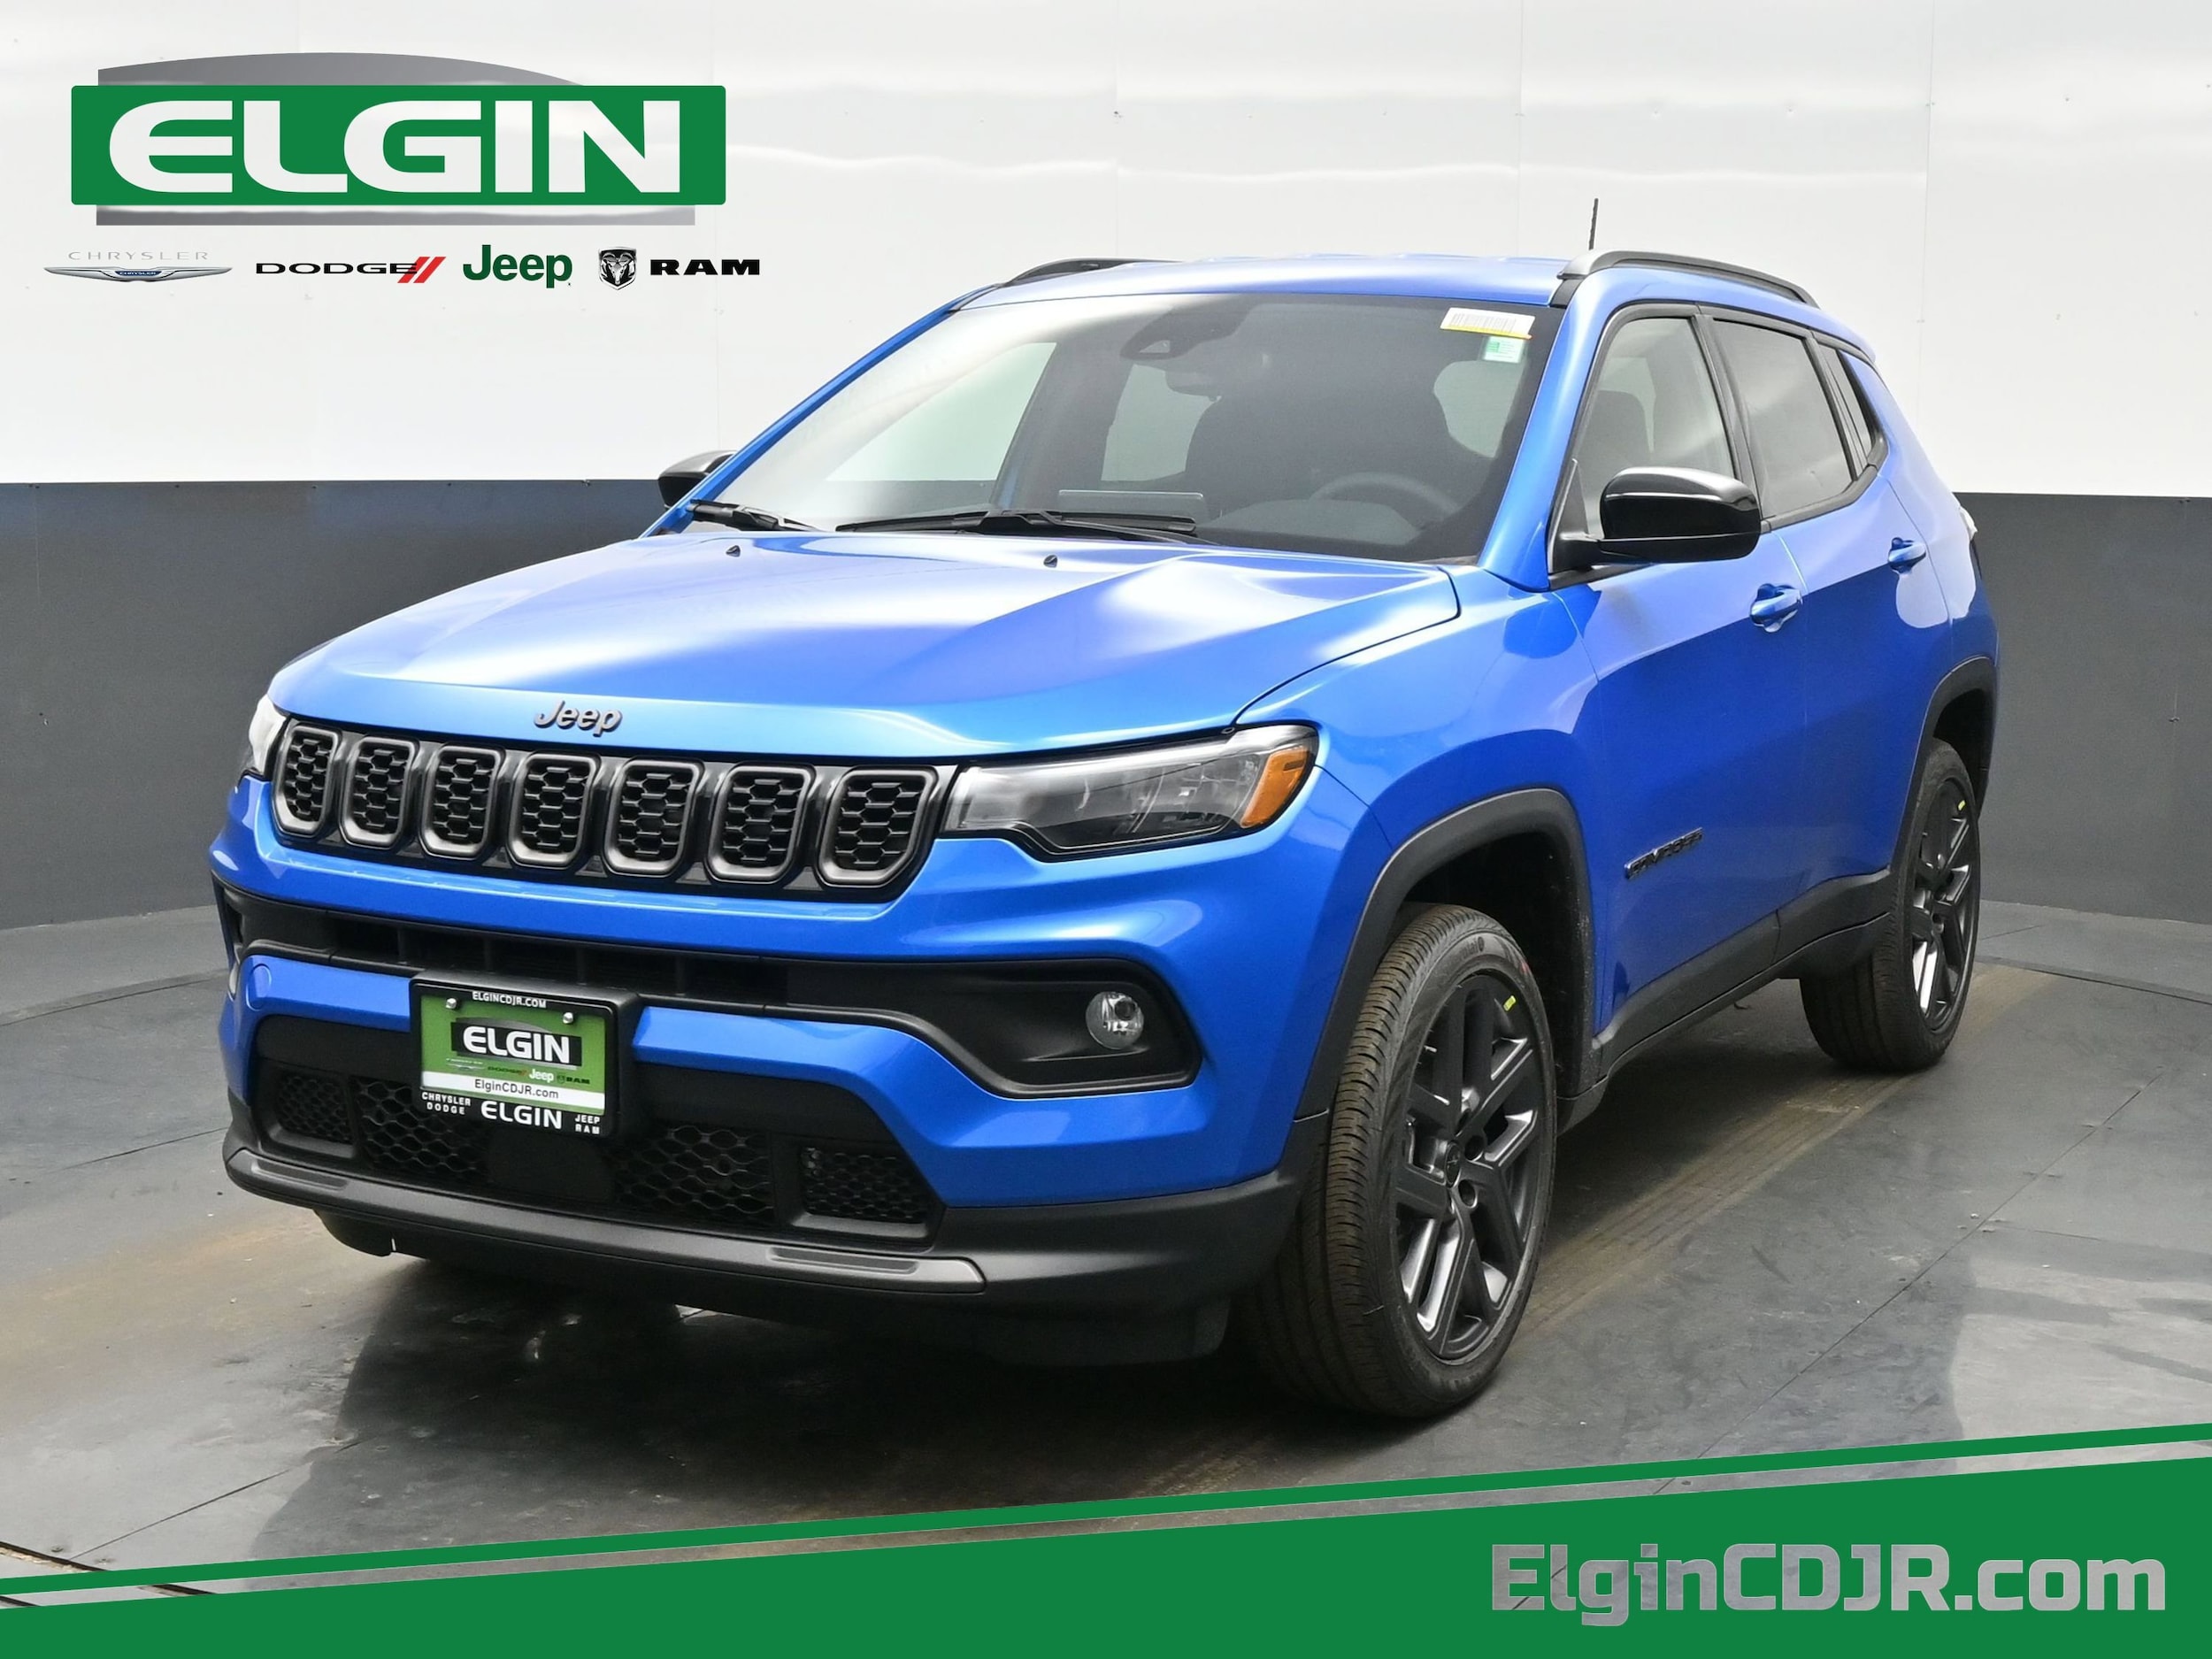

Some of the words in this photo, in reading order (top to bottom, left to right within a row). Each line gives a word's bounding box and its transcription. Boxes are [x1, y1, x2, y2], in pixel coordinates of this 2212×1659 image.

[534, 700, 623, 738] Jeep
[472, 991, 547, 1009] ELGINCDJR.COM
[463, 1025, 570, 1064] ELGIN
[528, 1068, 554, 1083] Jeep
[474, 1079, 559, 1099] ElginCDJR.com
[421, 1091, 472, 1106] CHRYSLER
[426, 1102, 465, 1115] DODGE
[480, 1101, 563, 1129] ELGIN
[575, 1114, 601, 1124] JEEP
[575, 1124, 601, 1134] RAM
